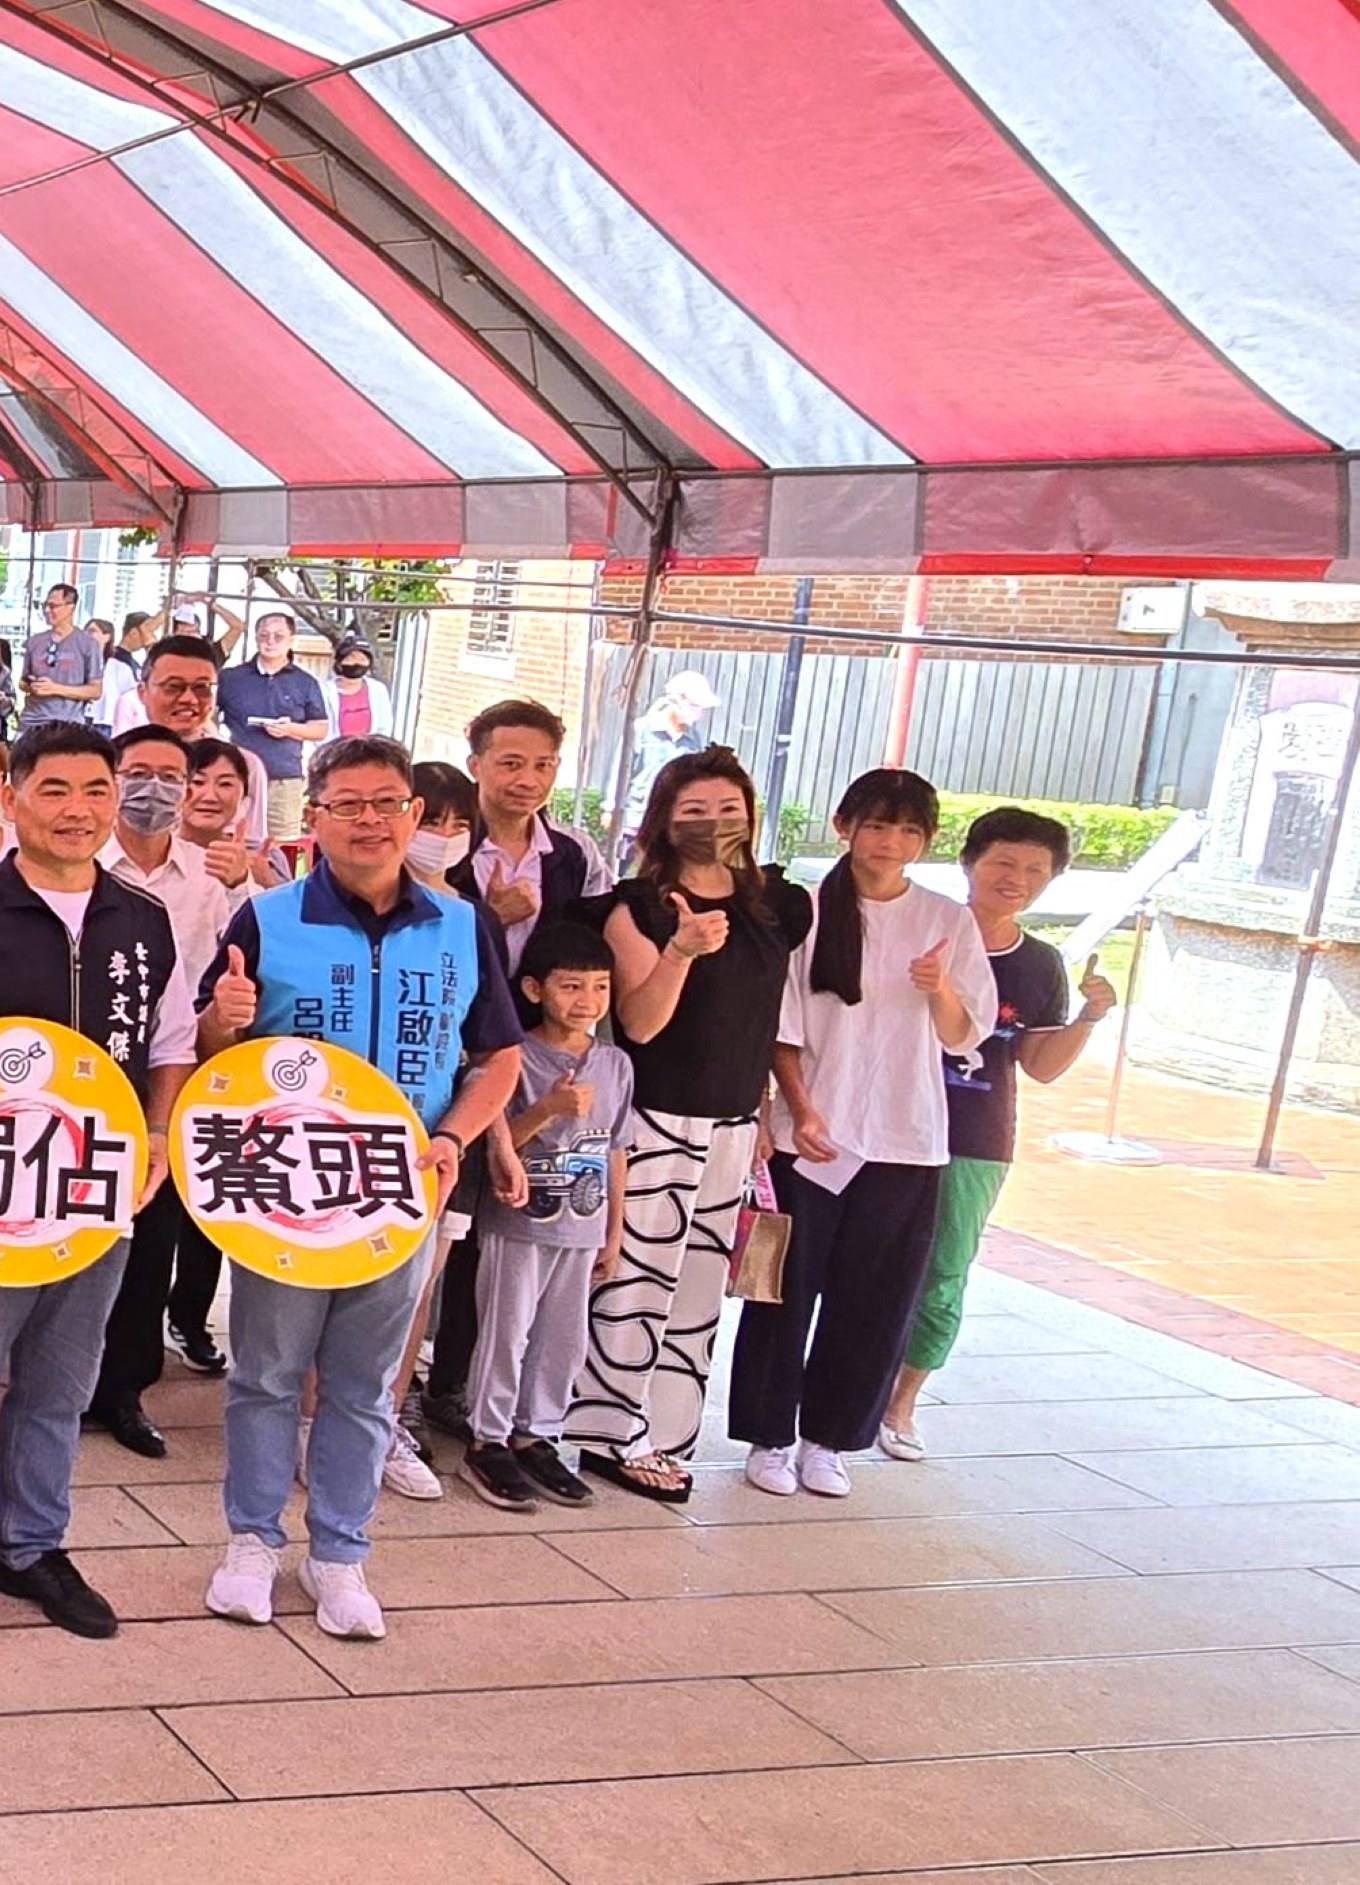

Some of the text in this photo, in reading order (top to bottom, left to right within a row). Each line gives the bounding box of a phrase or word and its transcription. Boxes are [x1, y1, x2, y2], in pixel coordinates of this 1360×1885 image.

[107, 950, 135, 1062] 李文傑
[293, 998, 324, 1041] 呂
[331, 963, 355, 1033] 副主任
[192, 1113, 423, 1220] 鰲頭
